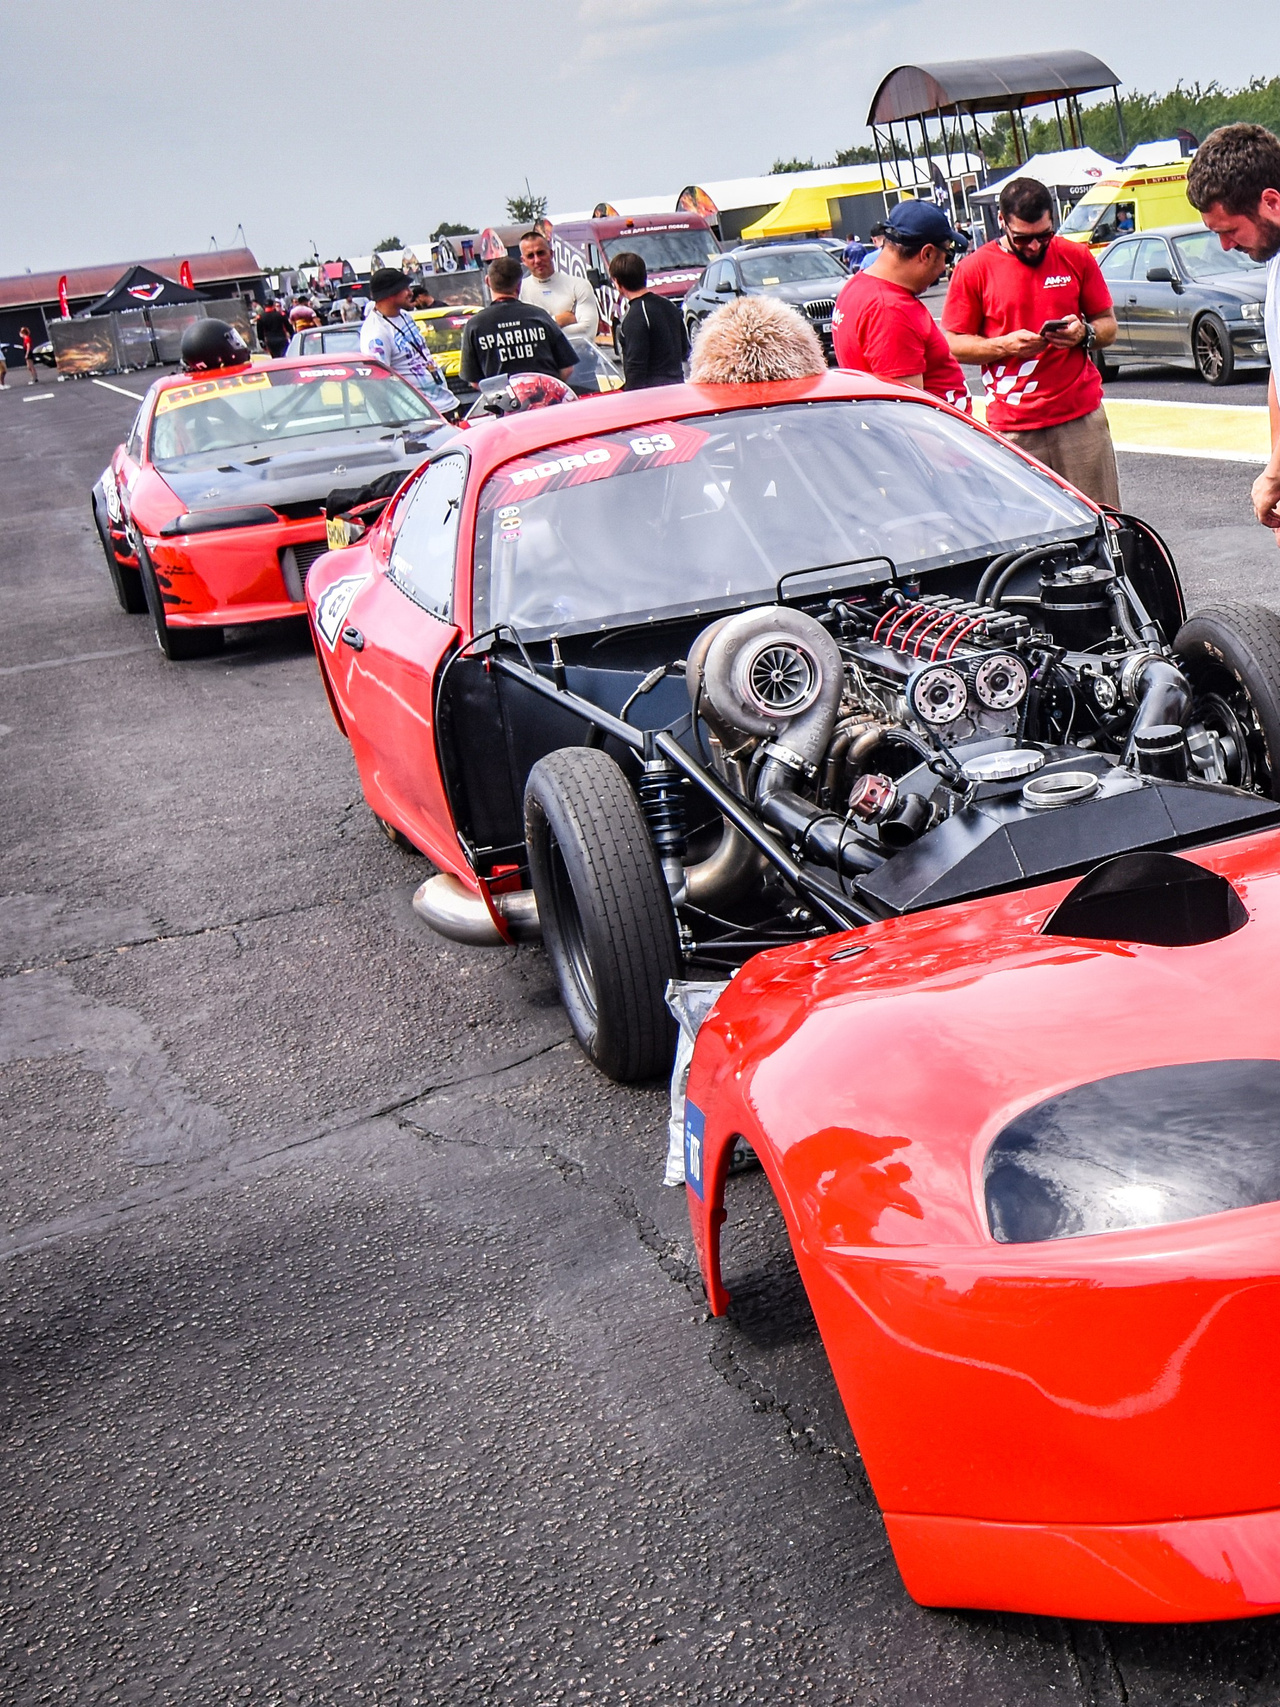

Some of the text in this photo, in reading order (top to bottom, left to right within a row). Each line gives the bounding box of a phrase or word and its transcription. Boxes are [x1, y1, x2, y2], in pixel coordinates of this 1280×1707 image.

[478, 327, 546, 351] SPARRING
[499, 345, 534, 363] CLUB
[355, 367, 372, 377] 17
[629, 433, 676, 456] 63
